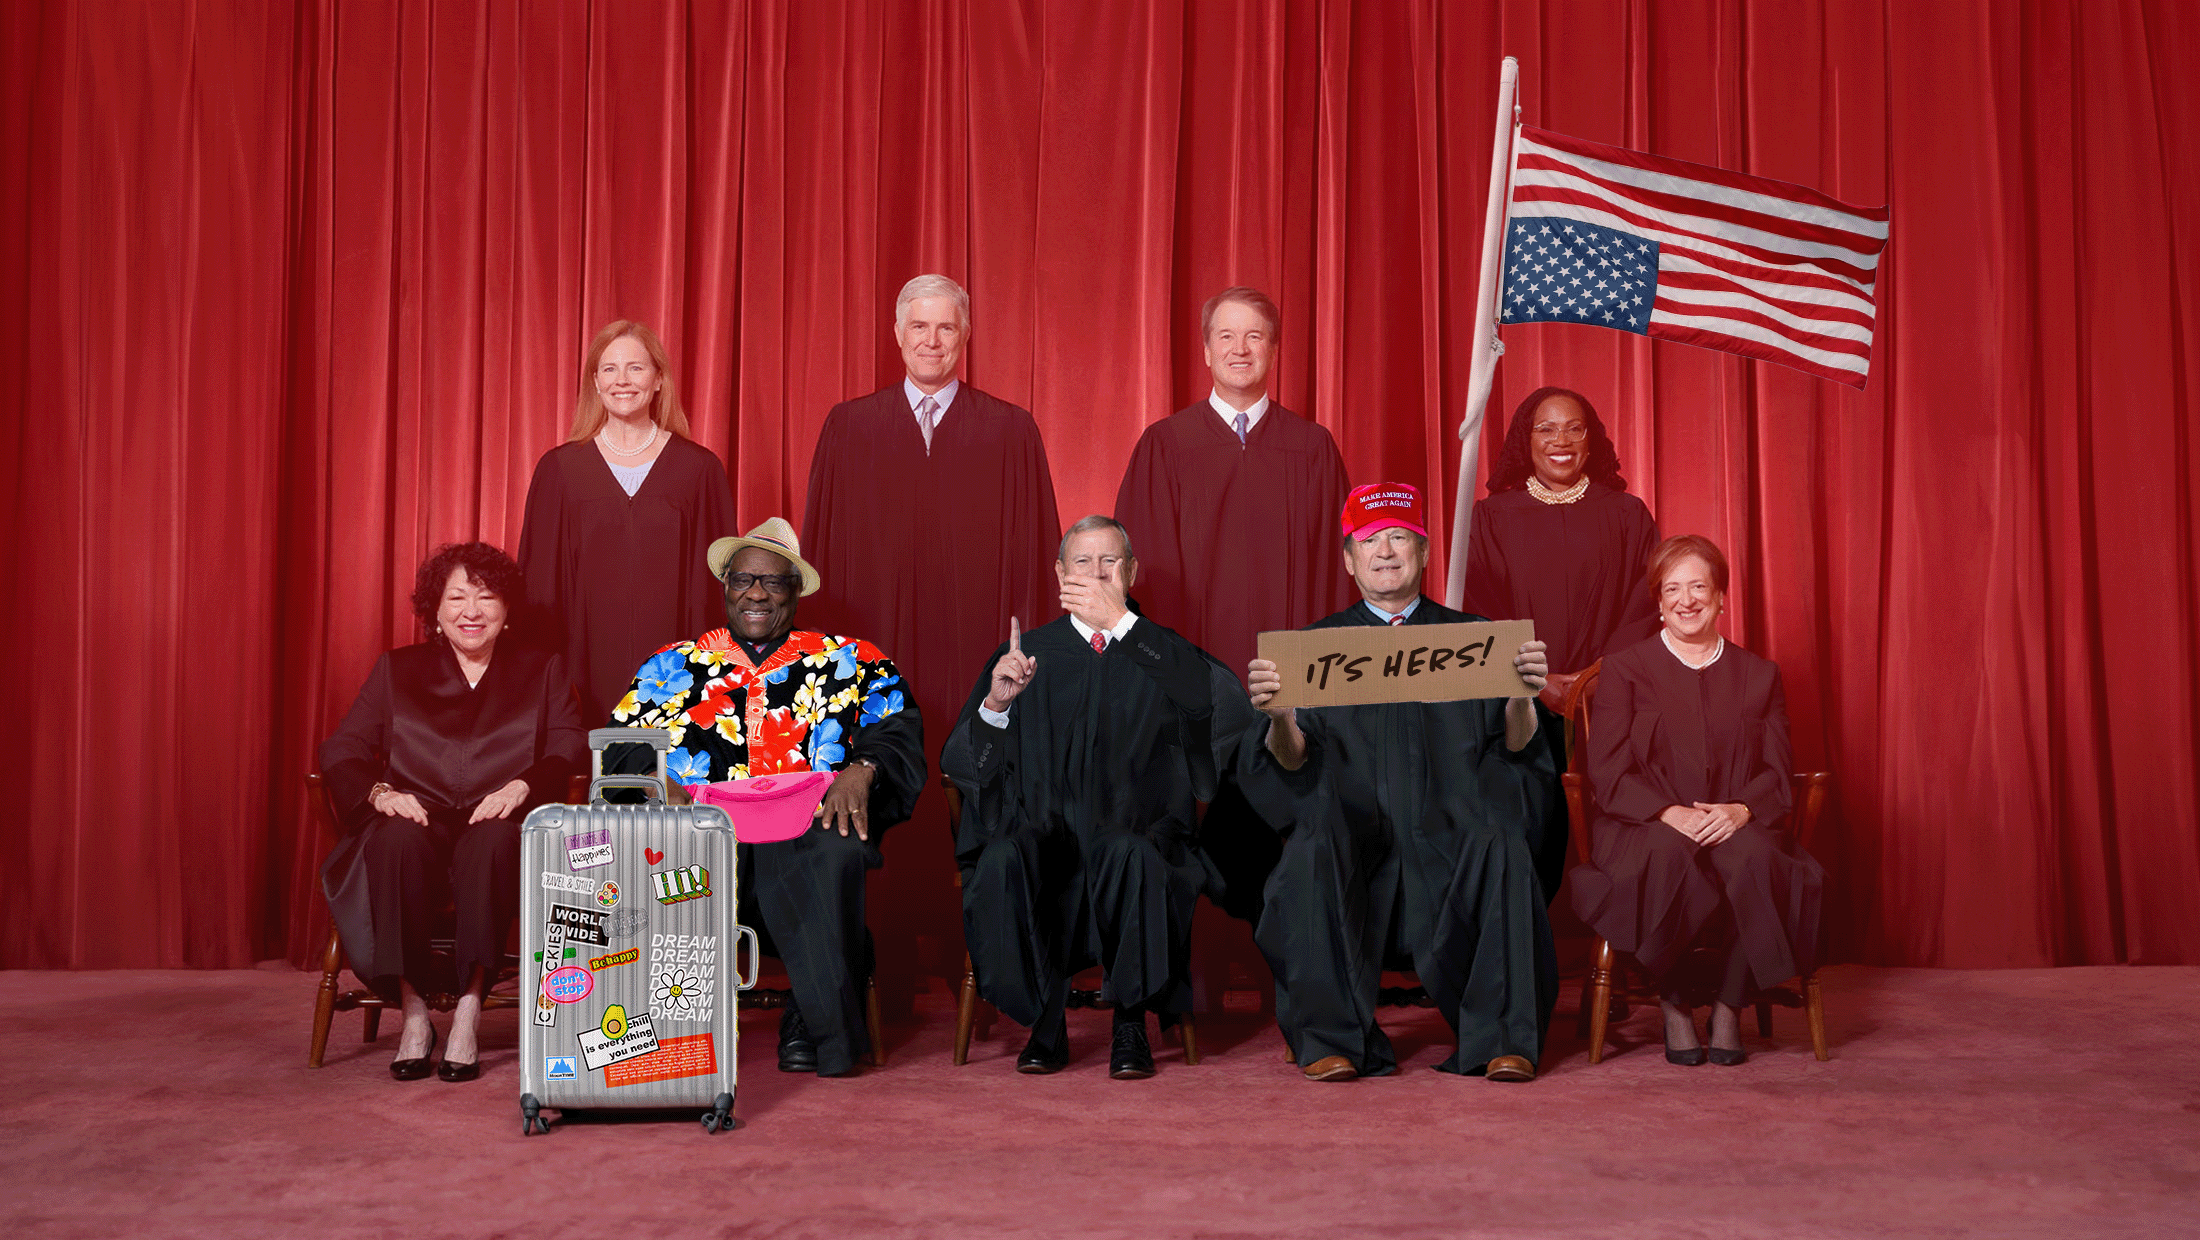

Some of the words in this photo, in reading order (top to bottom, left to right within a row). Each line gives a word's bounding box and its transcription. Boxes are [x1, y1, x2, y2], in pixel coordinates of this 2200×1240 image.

[1360, 492, 1381, 503] MAKE
[1382, 491, 1414, 500] AMERICA
[1364, 500, 1389, 510] GREAT
[1390, 499, 1412, 508] AGAIN
[1306, 652, 1372, 690] IT'S
[1383, 635, 1495, 678] HERS!
[567, 878, 573, 889] &
[650, 864, 713, 905] Hi!
[651, 934, 717, 950] DREAM
[651, 948, 716, 964] DREAM
[551, 971, 586, 986] don't
[554, 983, 585, 996] stop
[650, 1006, 713, 1022] DREAM
[628, 1016, 649, 1029] chill
[585, 1046, 596, 1054] is
[598, 1029, 653, 1050] everything
[609, 1048, 628, 1061] you
[630, 1039, 656, 1052] need
